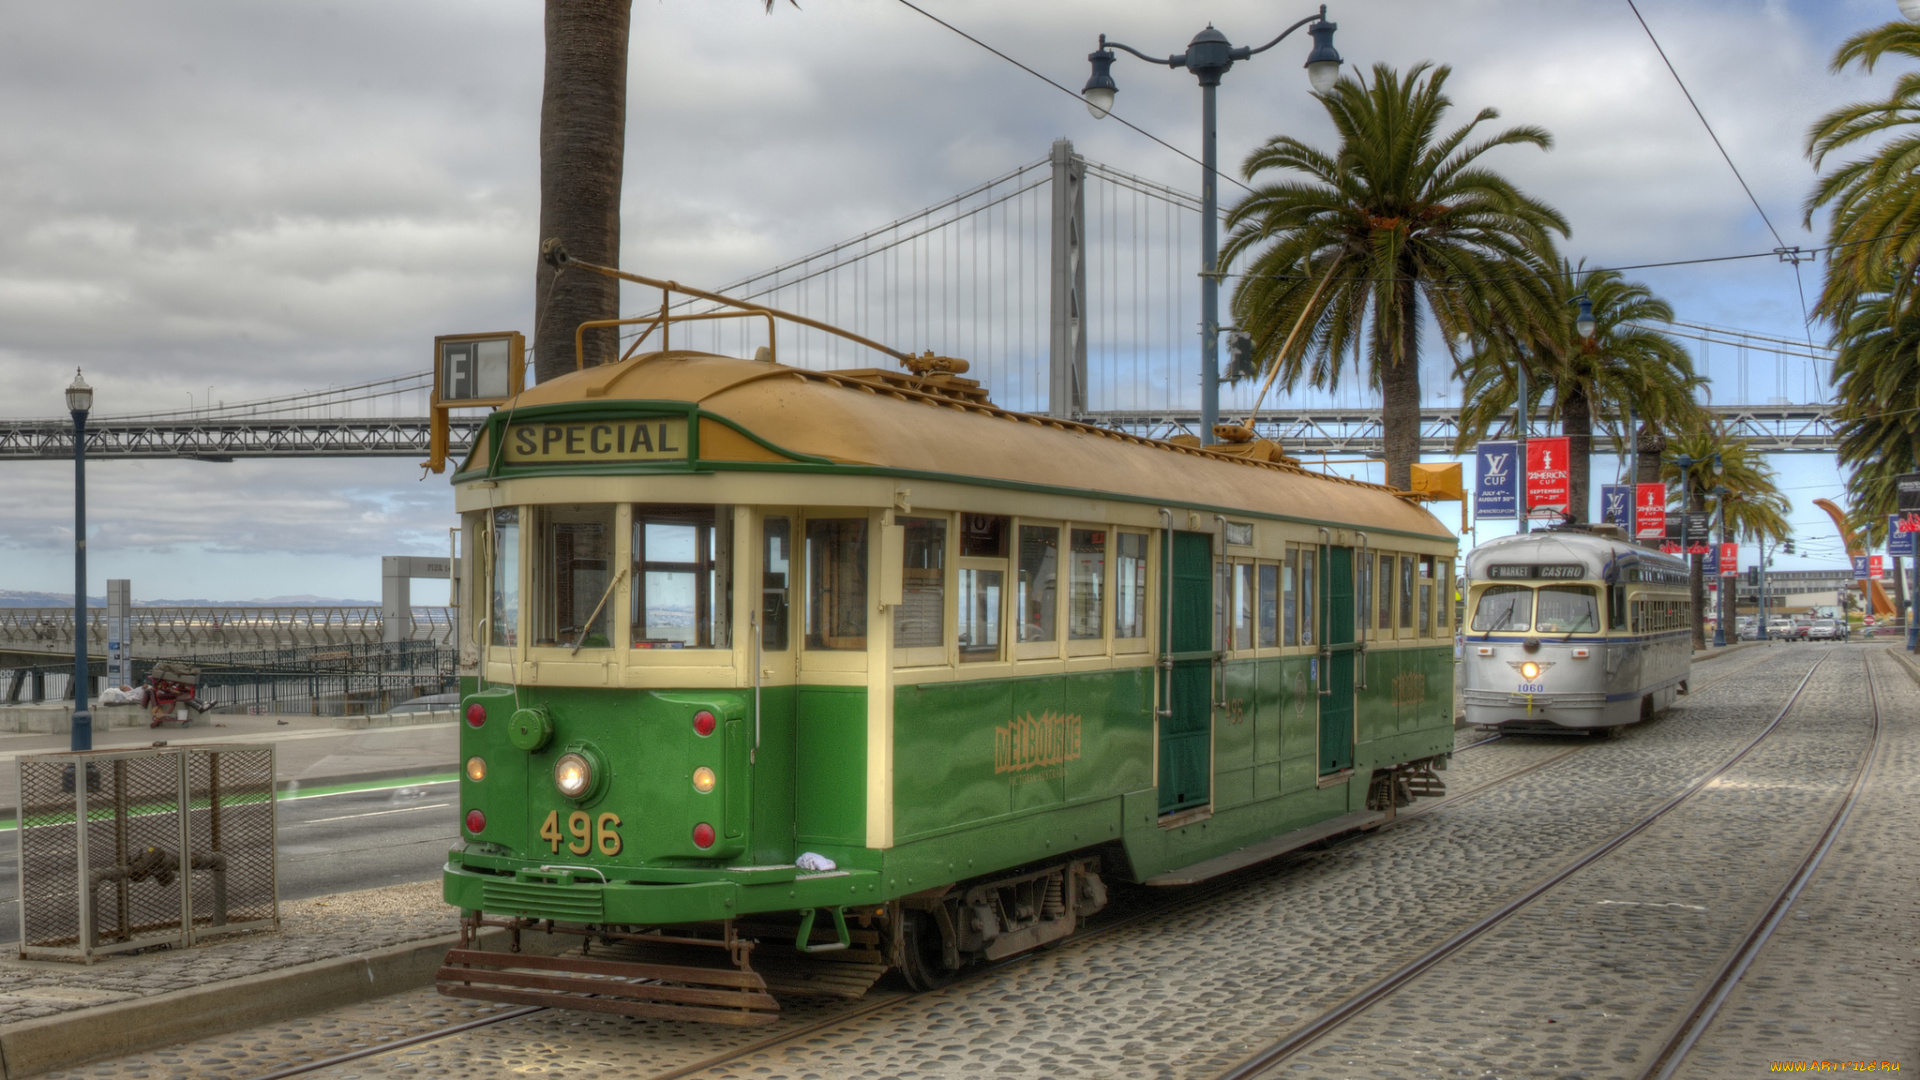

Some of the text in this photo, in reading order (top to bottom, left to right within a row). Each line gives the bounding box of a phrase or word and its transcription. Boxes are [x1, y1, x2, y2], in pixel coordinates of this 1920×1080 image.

[450, 353, 467, 399] F
[515, 424, 679, 456] SPECIAL
[1484, 477, 1506, 485] CUP
[427, 563, 443, 572] PIER
[1492, 566, 1528, 577] F MARKET
[1541, 566, 1581, 577] CASTRO
[1518, 683, 1544, 693] 1060
[1225, 697, 1244, 726] 496
[995, 707, 1082, 775] MELBOURNE
[540, 809, 622, 857] 496
